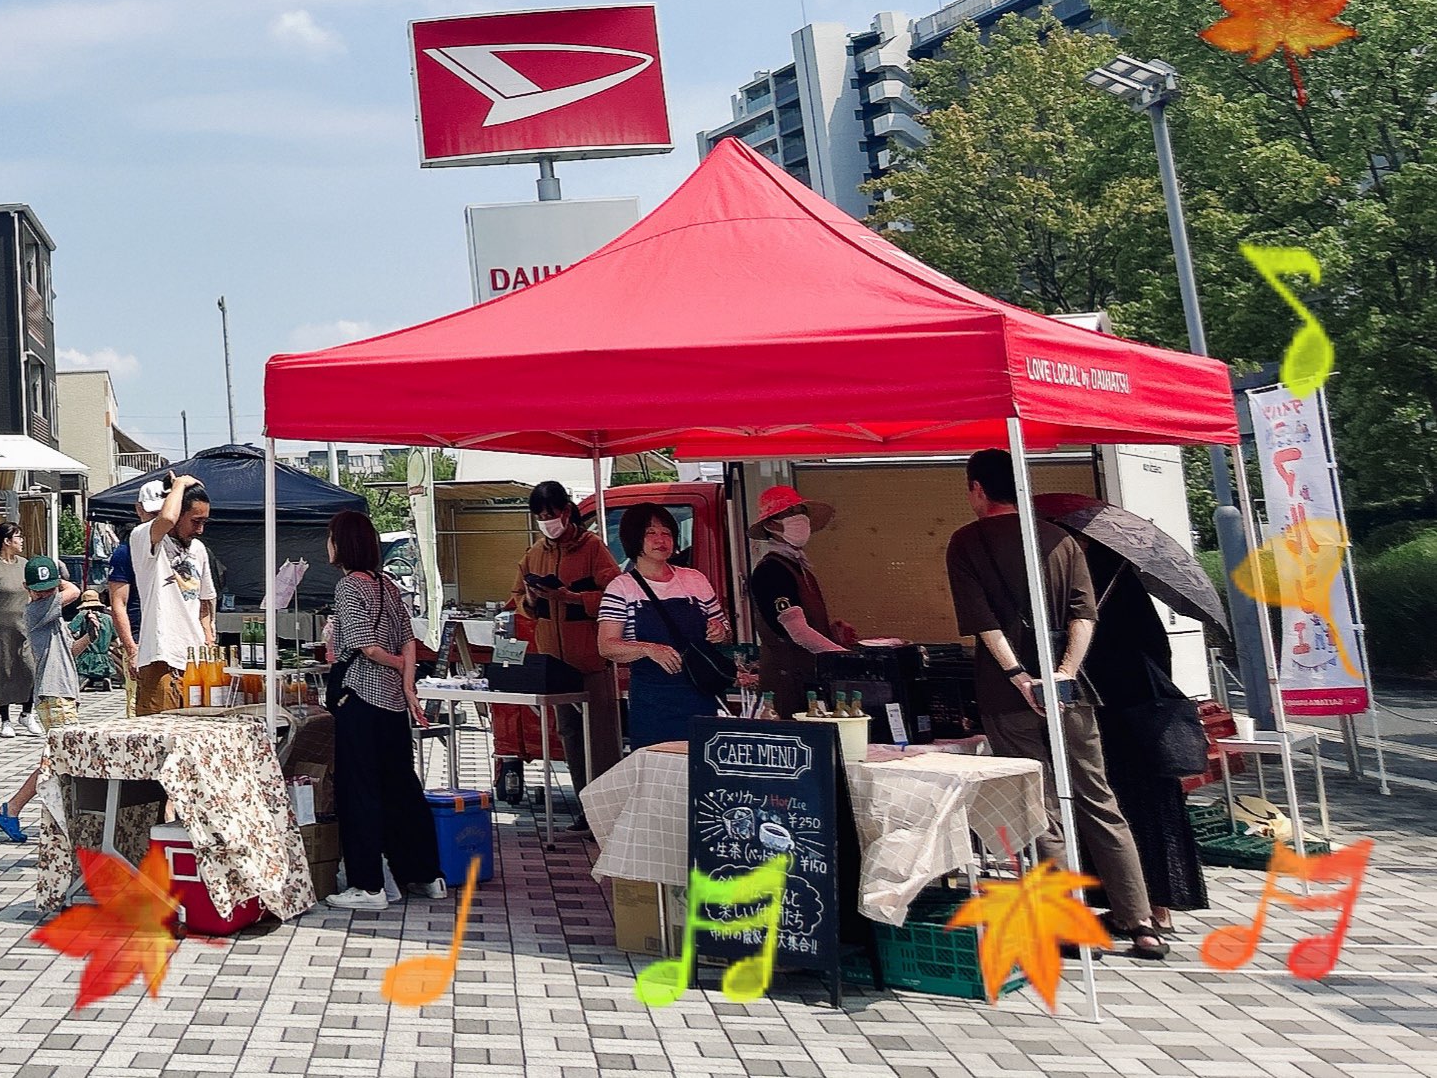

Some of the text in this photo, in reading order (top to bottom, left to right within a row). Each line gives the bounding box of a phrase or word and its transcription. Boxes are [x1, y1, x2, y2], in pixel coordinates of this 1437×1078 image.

[490, 265, 572, 290] DAIH
[1025, 356, 1052, 383] LOVE
[1051, 361, 1082, 387] LOCAL
[1090, 367, 1132, 394] DAIHATSU
[716, 742, 798, 769] CAFE MENU
[716, 788, 767, 808] アメリカーノ
[788, 811, 821, 829] ¥250
[800, 855, 827, 873] ¥150
